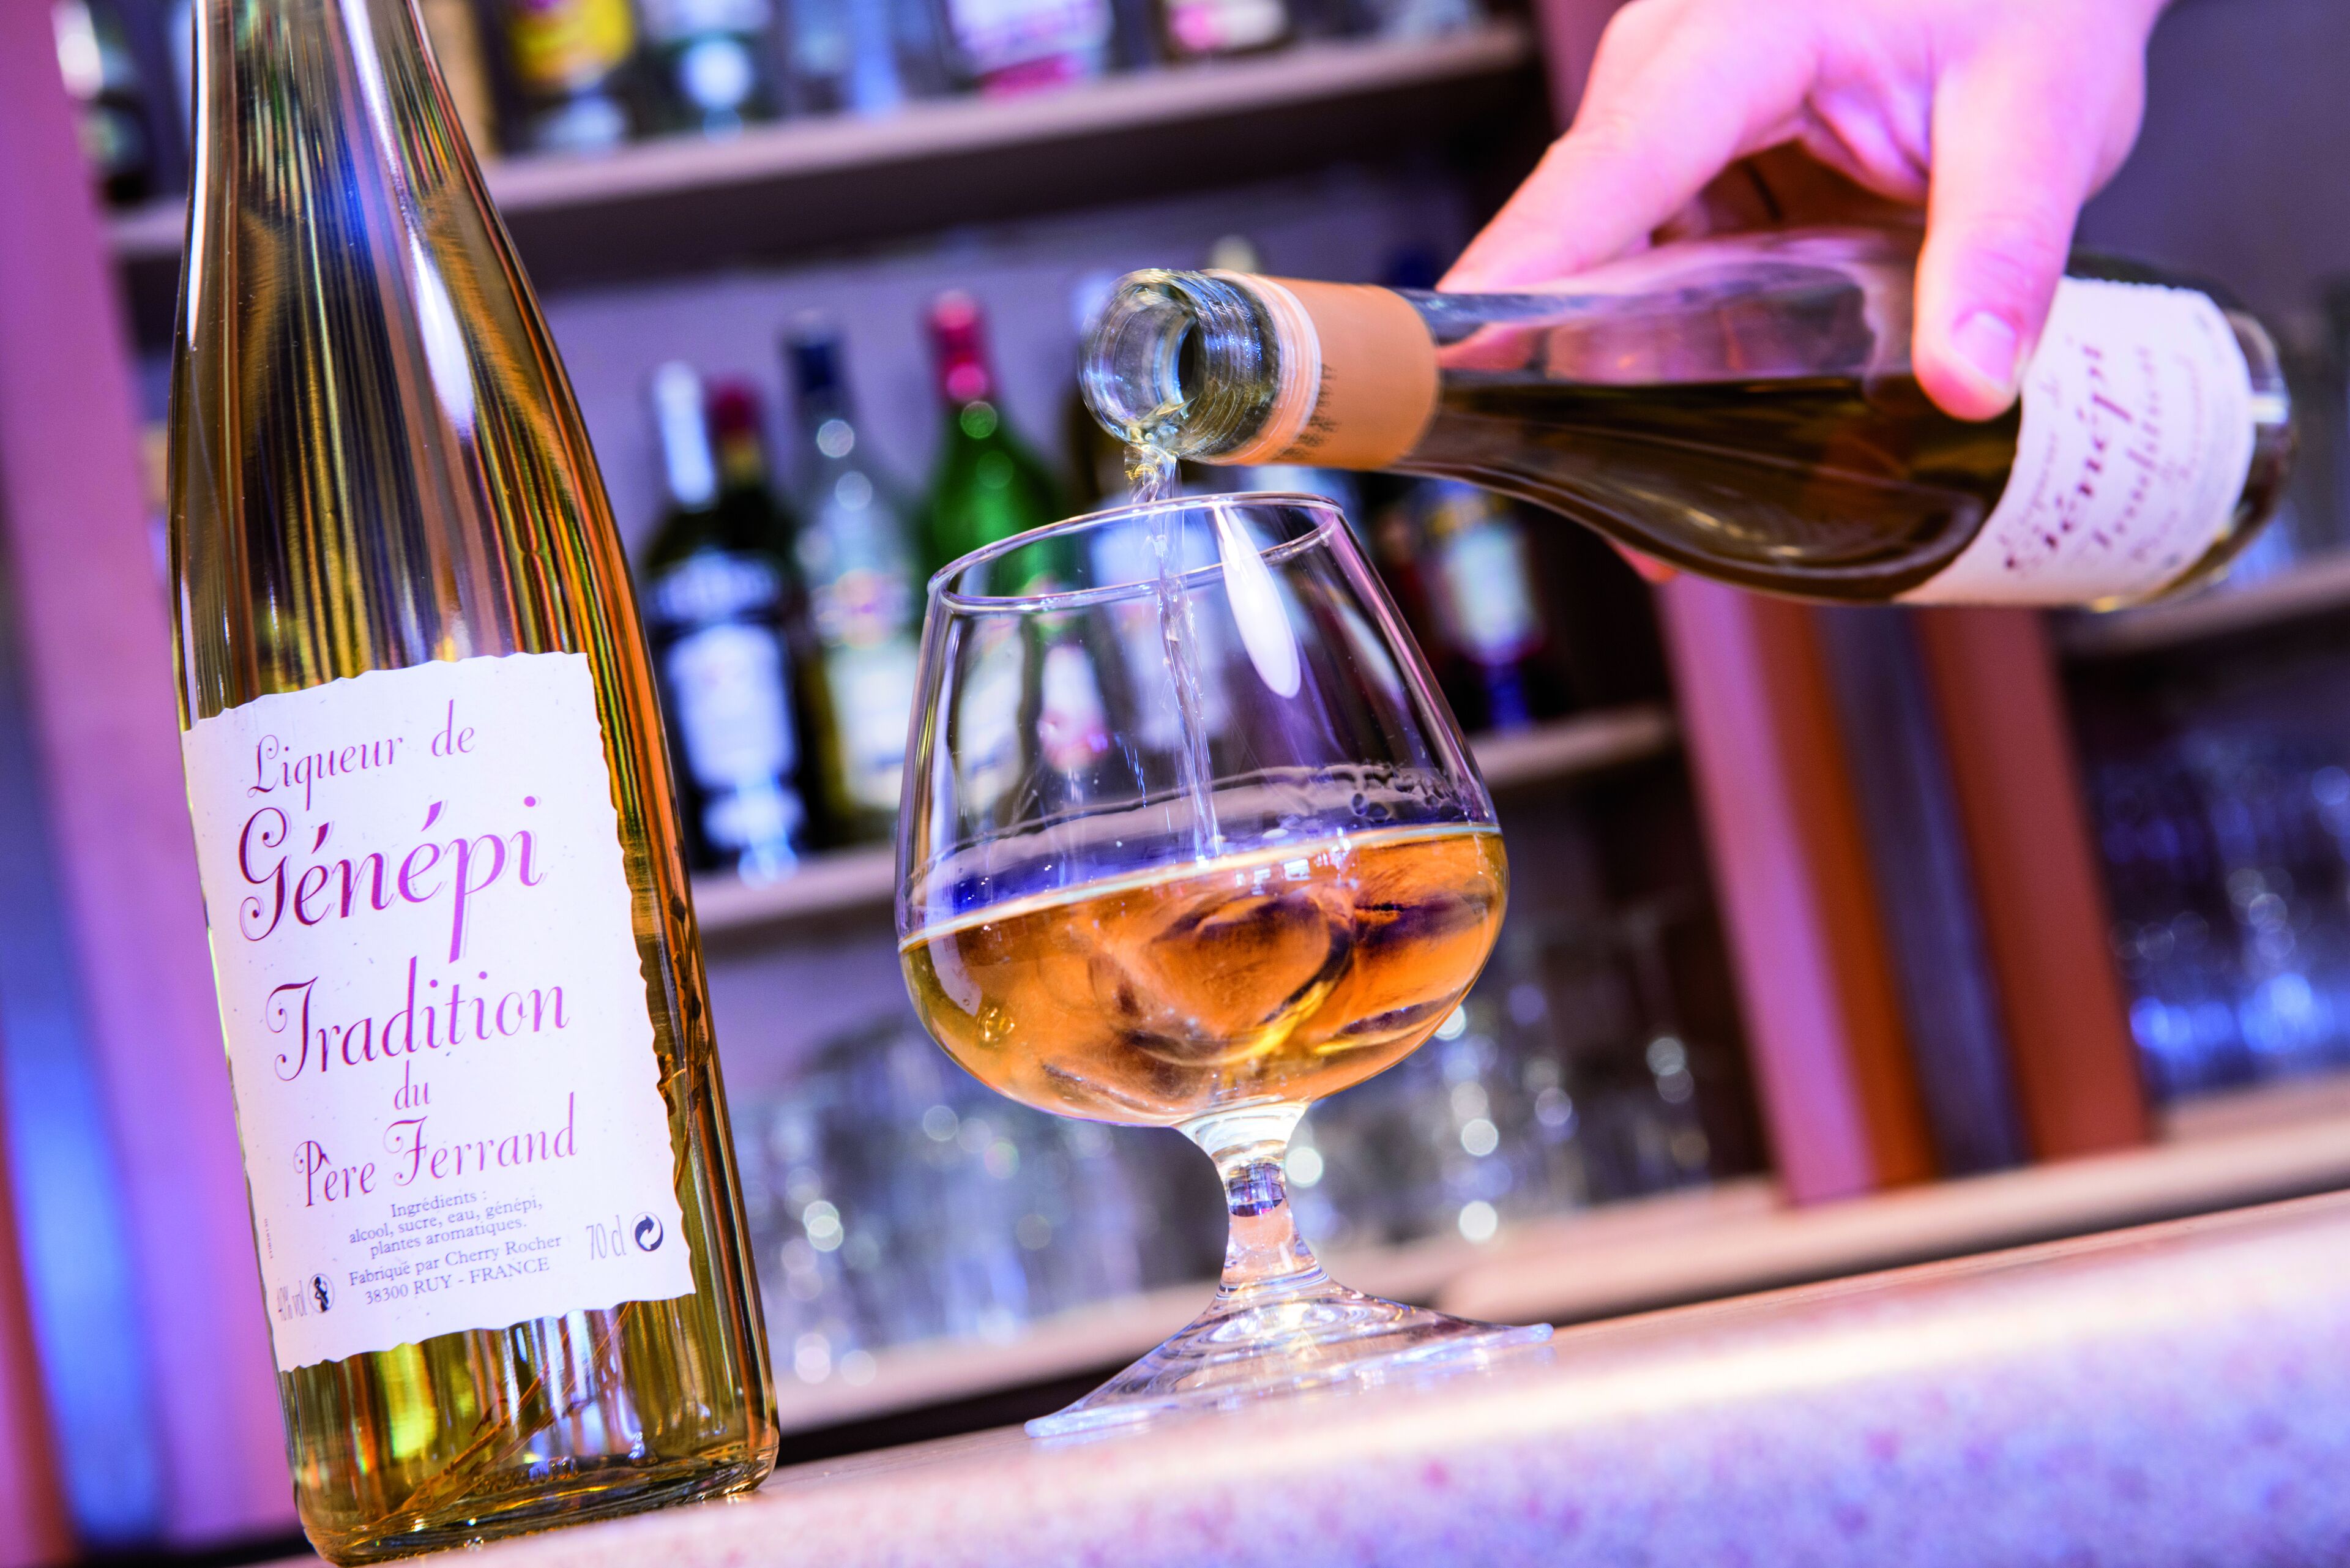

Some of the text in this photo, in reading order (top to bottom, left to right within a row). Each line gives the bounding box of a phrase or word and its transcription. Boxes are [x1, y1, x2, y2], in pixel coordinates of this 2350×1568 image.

[247, 699, 476, 811] Liqueur de
[238, 796, 548, 963] Génépi
[265, 955, 570, 1081] Tradition
[394, 1059, 431, 1111] du
[293, 1091, 578, 1208] Père Ferrand
[349, 1194, 543, 1244] alcool, sucre, eau, génépi,
[390, 1192, 477, 1218] Ingrédients
[349, 1234, 562, 1286] Fabriqué par Cherry Rocher
[370, 1218, 528, 1260] plantes aromatiques.
[586, 1223, 607, 1260] 70
[365, 1283, 409, 1305] 38300
[414, 1274, 452, 1294] RUY
[469, 1256, 550, 1284] FRANCE
